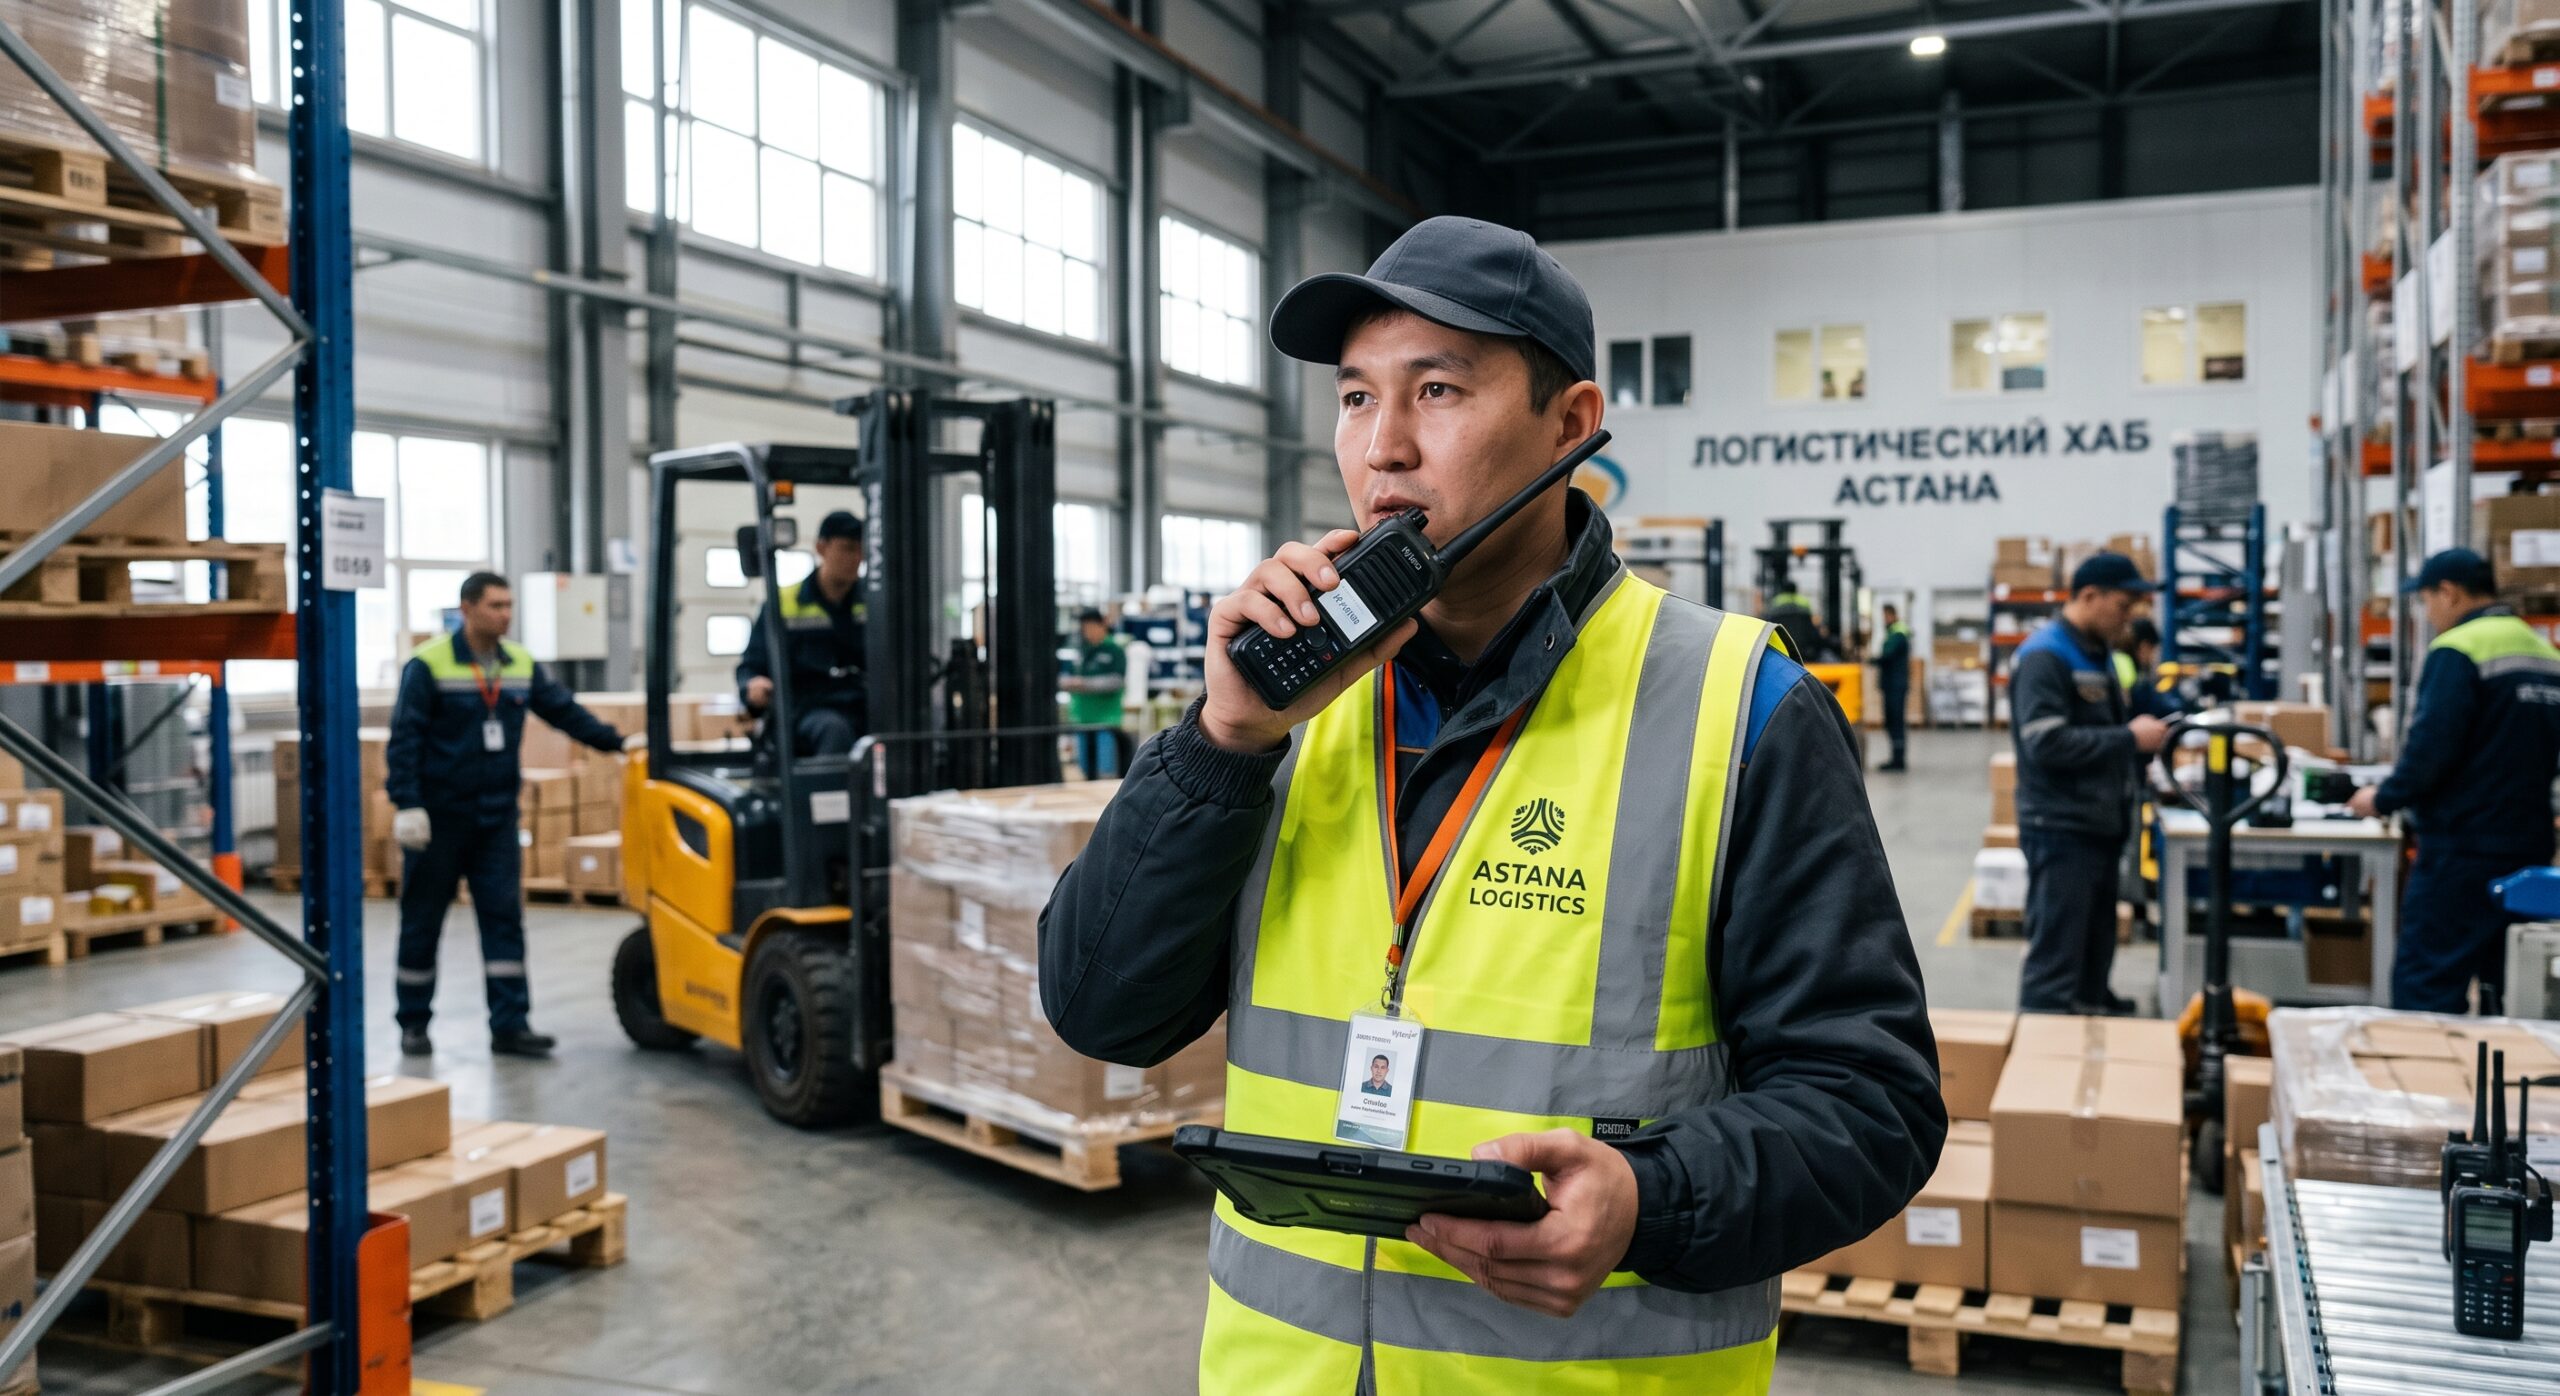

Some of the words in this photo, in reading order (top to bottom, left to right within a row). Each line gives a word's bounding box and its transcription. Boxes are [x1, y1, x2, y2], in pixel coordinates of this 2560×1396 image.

[1692, 417, 2048, 468] ЛОГИСТИЧЕСКИЙ
[2062, 420, 2150, 455] ХАБ
[1833, 472, 2001, 506] АСТАНА
[1472, 860, 1587, 891] ASTANA
[1469, 887, 1586, 915] LOGISTICS
